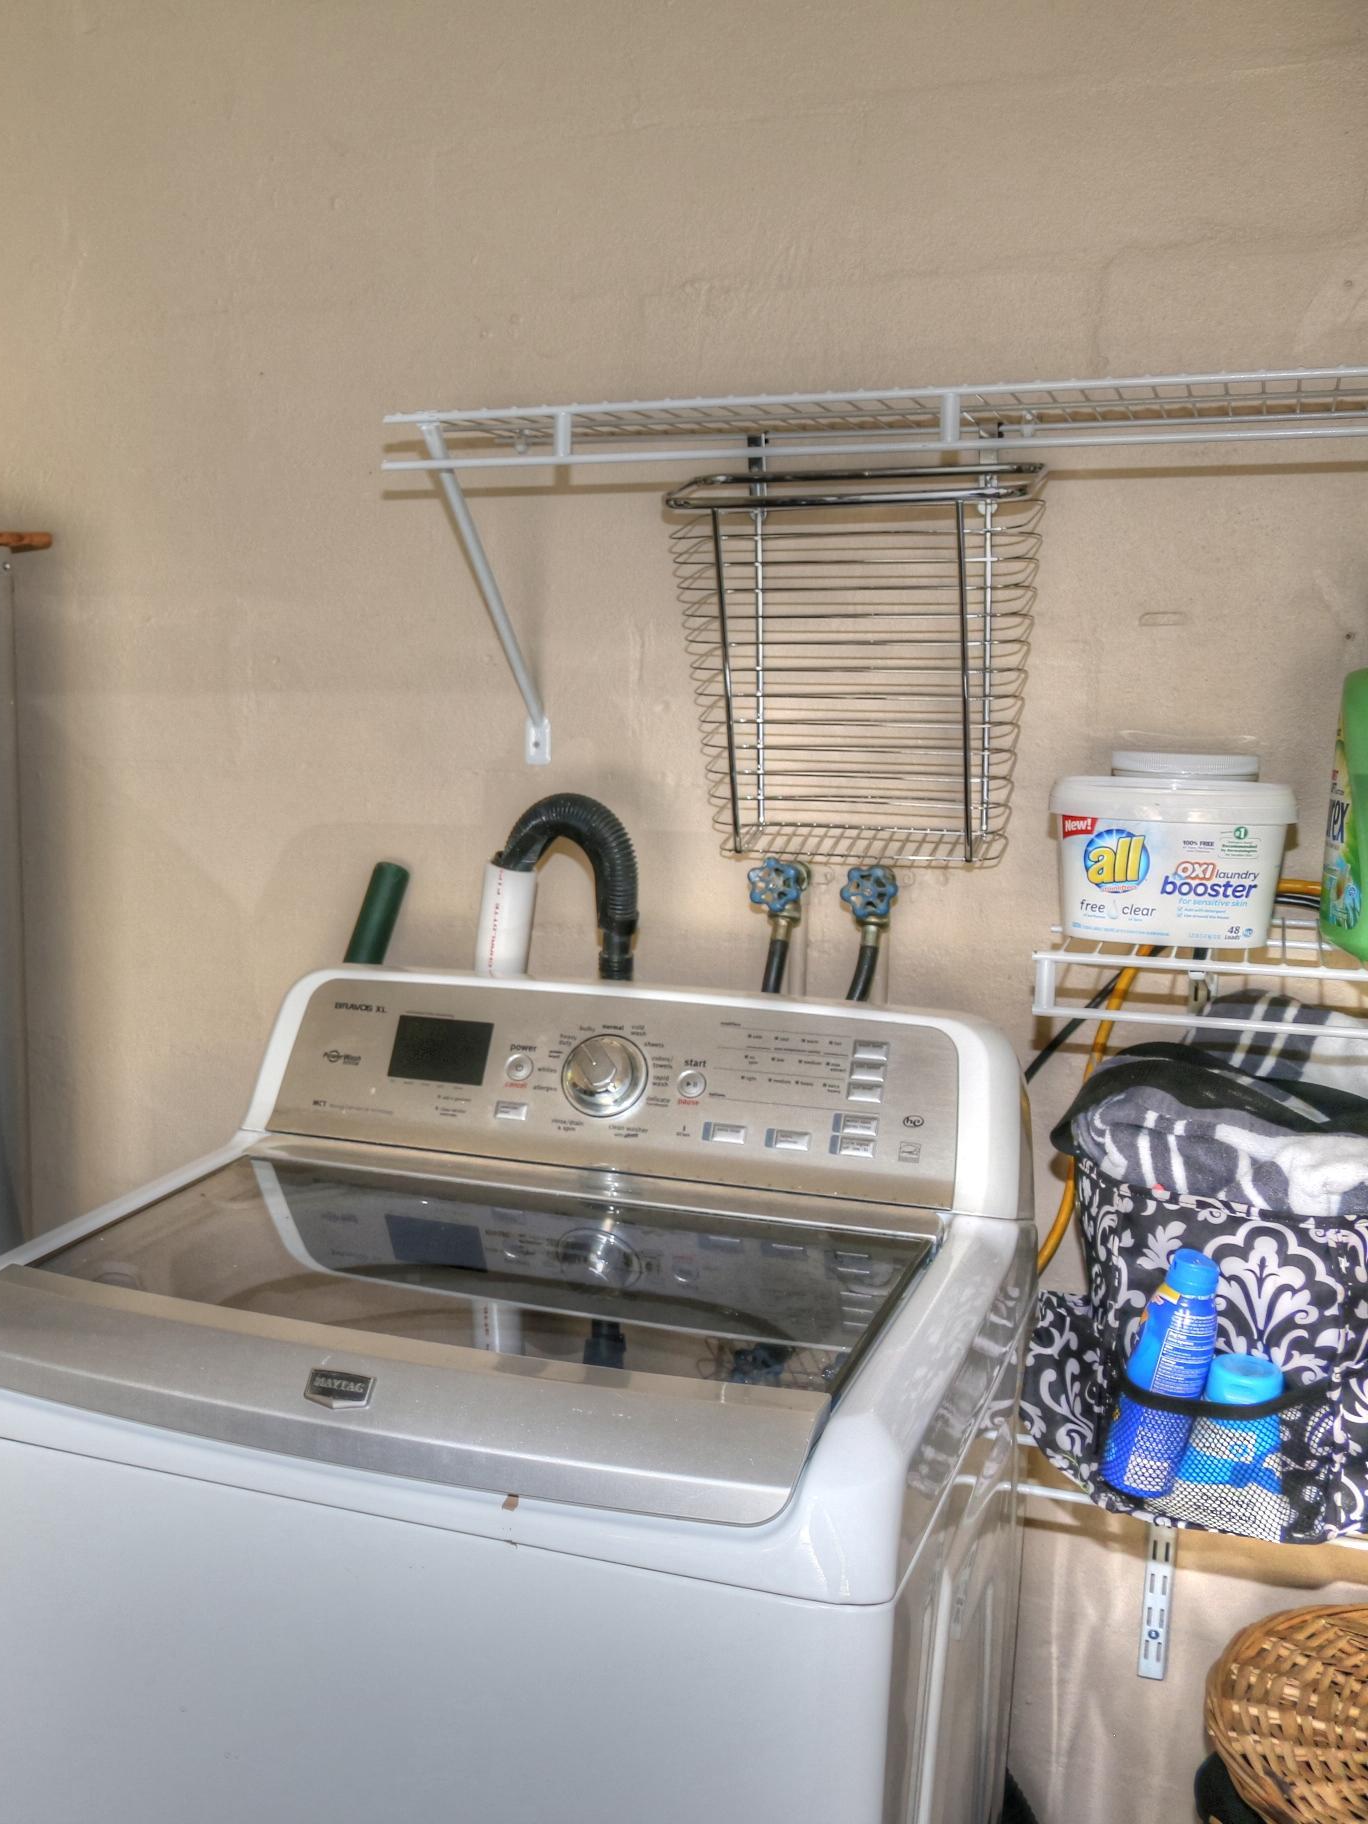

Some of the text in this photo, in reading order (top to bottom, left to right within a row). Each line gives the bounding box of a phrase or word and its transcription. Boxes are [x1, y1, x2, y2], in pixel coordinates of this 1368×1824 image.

[1064, 818, 1092, 832] New!
[1087, 835, 1146, 885] all
[1177, 862, 1260, 882] OXI laundry
[1160, 875, 1258, 899] booster
[1080, 899, 1156, 917] free clear
[1227, 926, 1240, 935] 48
[334, 1002, 373, 1013] BRAVOS
[510, 1044, 537, 1053] power
[684, 1058, 707, 1068] start
[313, 1377, 366, 1393] MAYTAG
